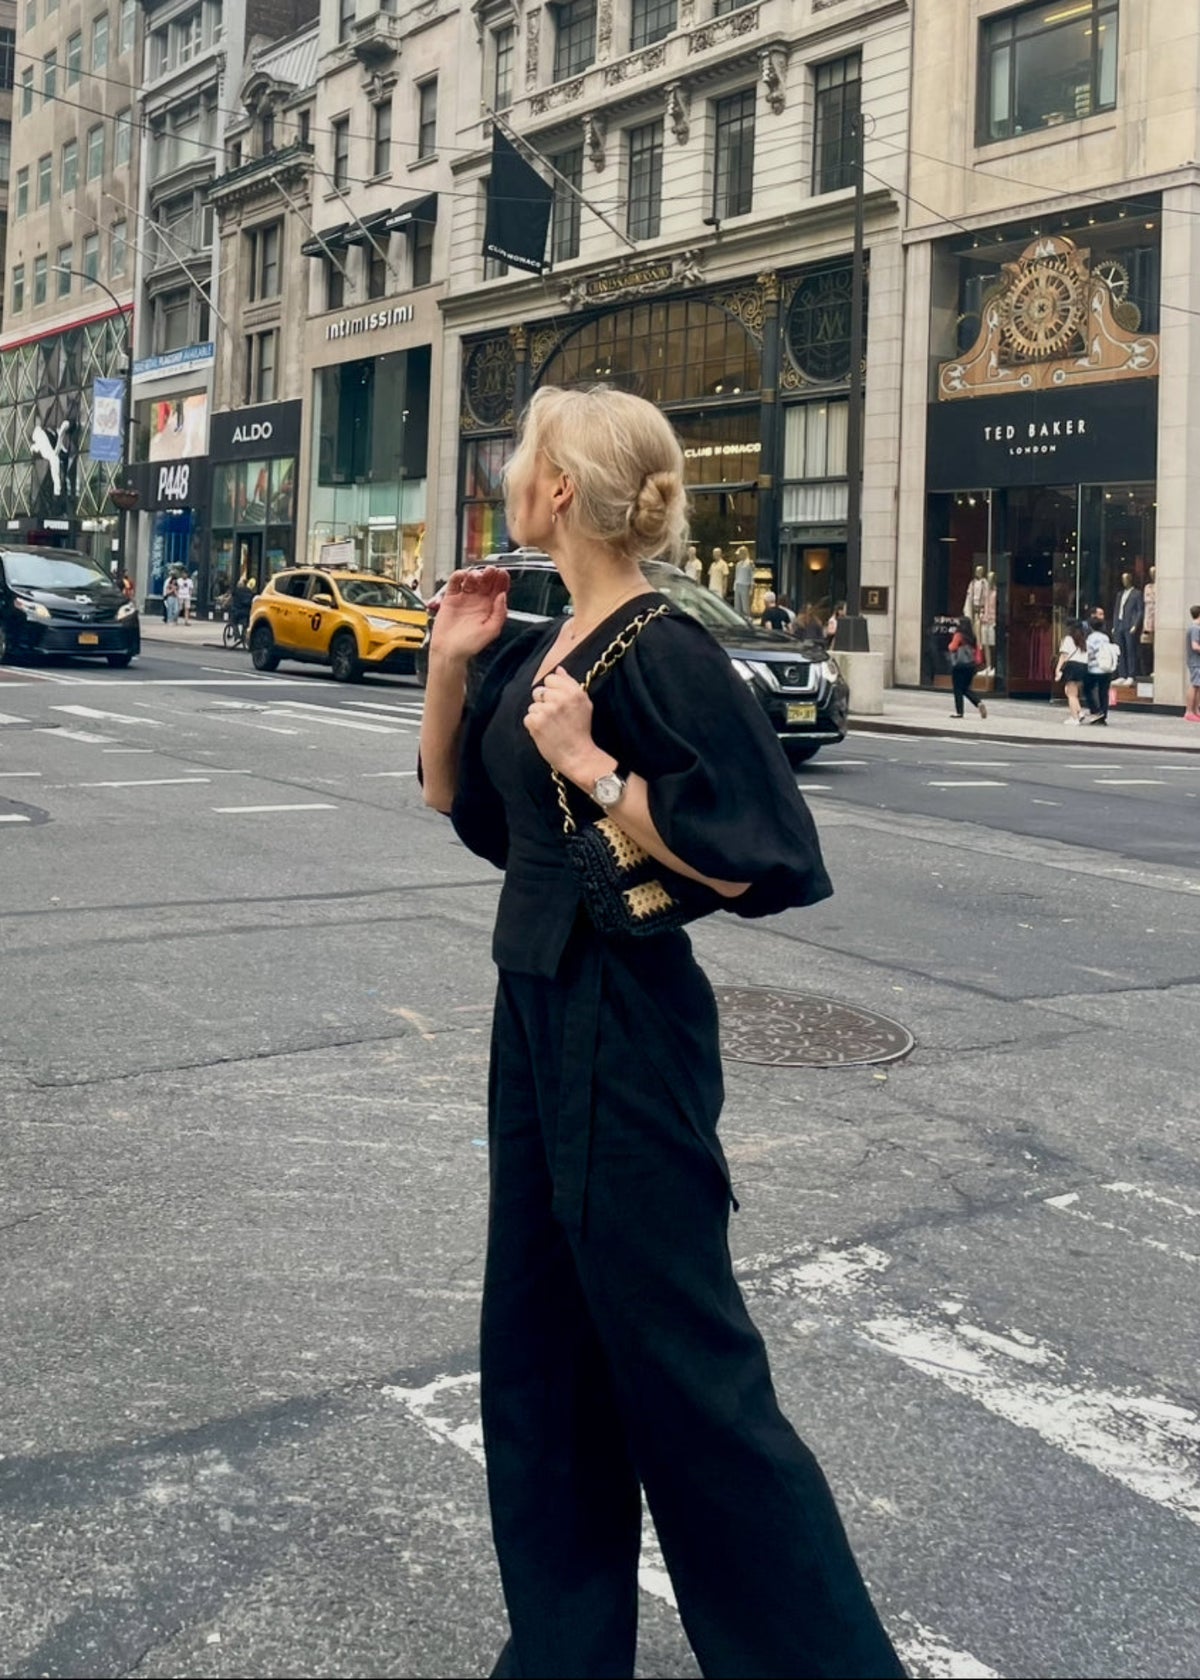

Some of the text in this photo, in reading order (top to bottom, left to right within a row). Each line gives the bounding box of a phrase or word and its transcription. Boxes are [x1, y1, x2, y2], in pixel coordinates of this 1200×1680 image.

[325, 303, 414, 340] intimissimi
[231, 420, 274, 444] ALDO
[984, 419, 1086, 441] TED BAKER
[684, 442, 762, 459] CLUB MONACO
[1009, 444, 1057, 456] LONDON
[157, 463, 190, 501] P448
